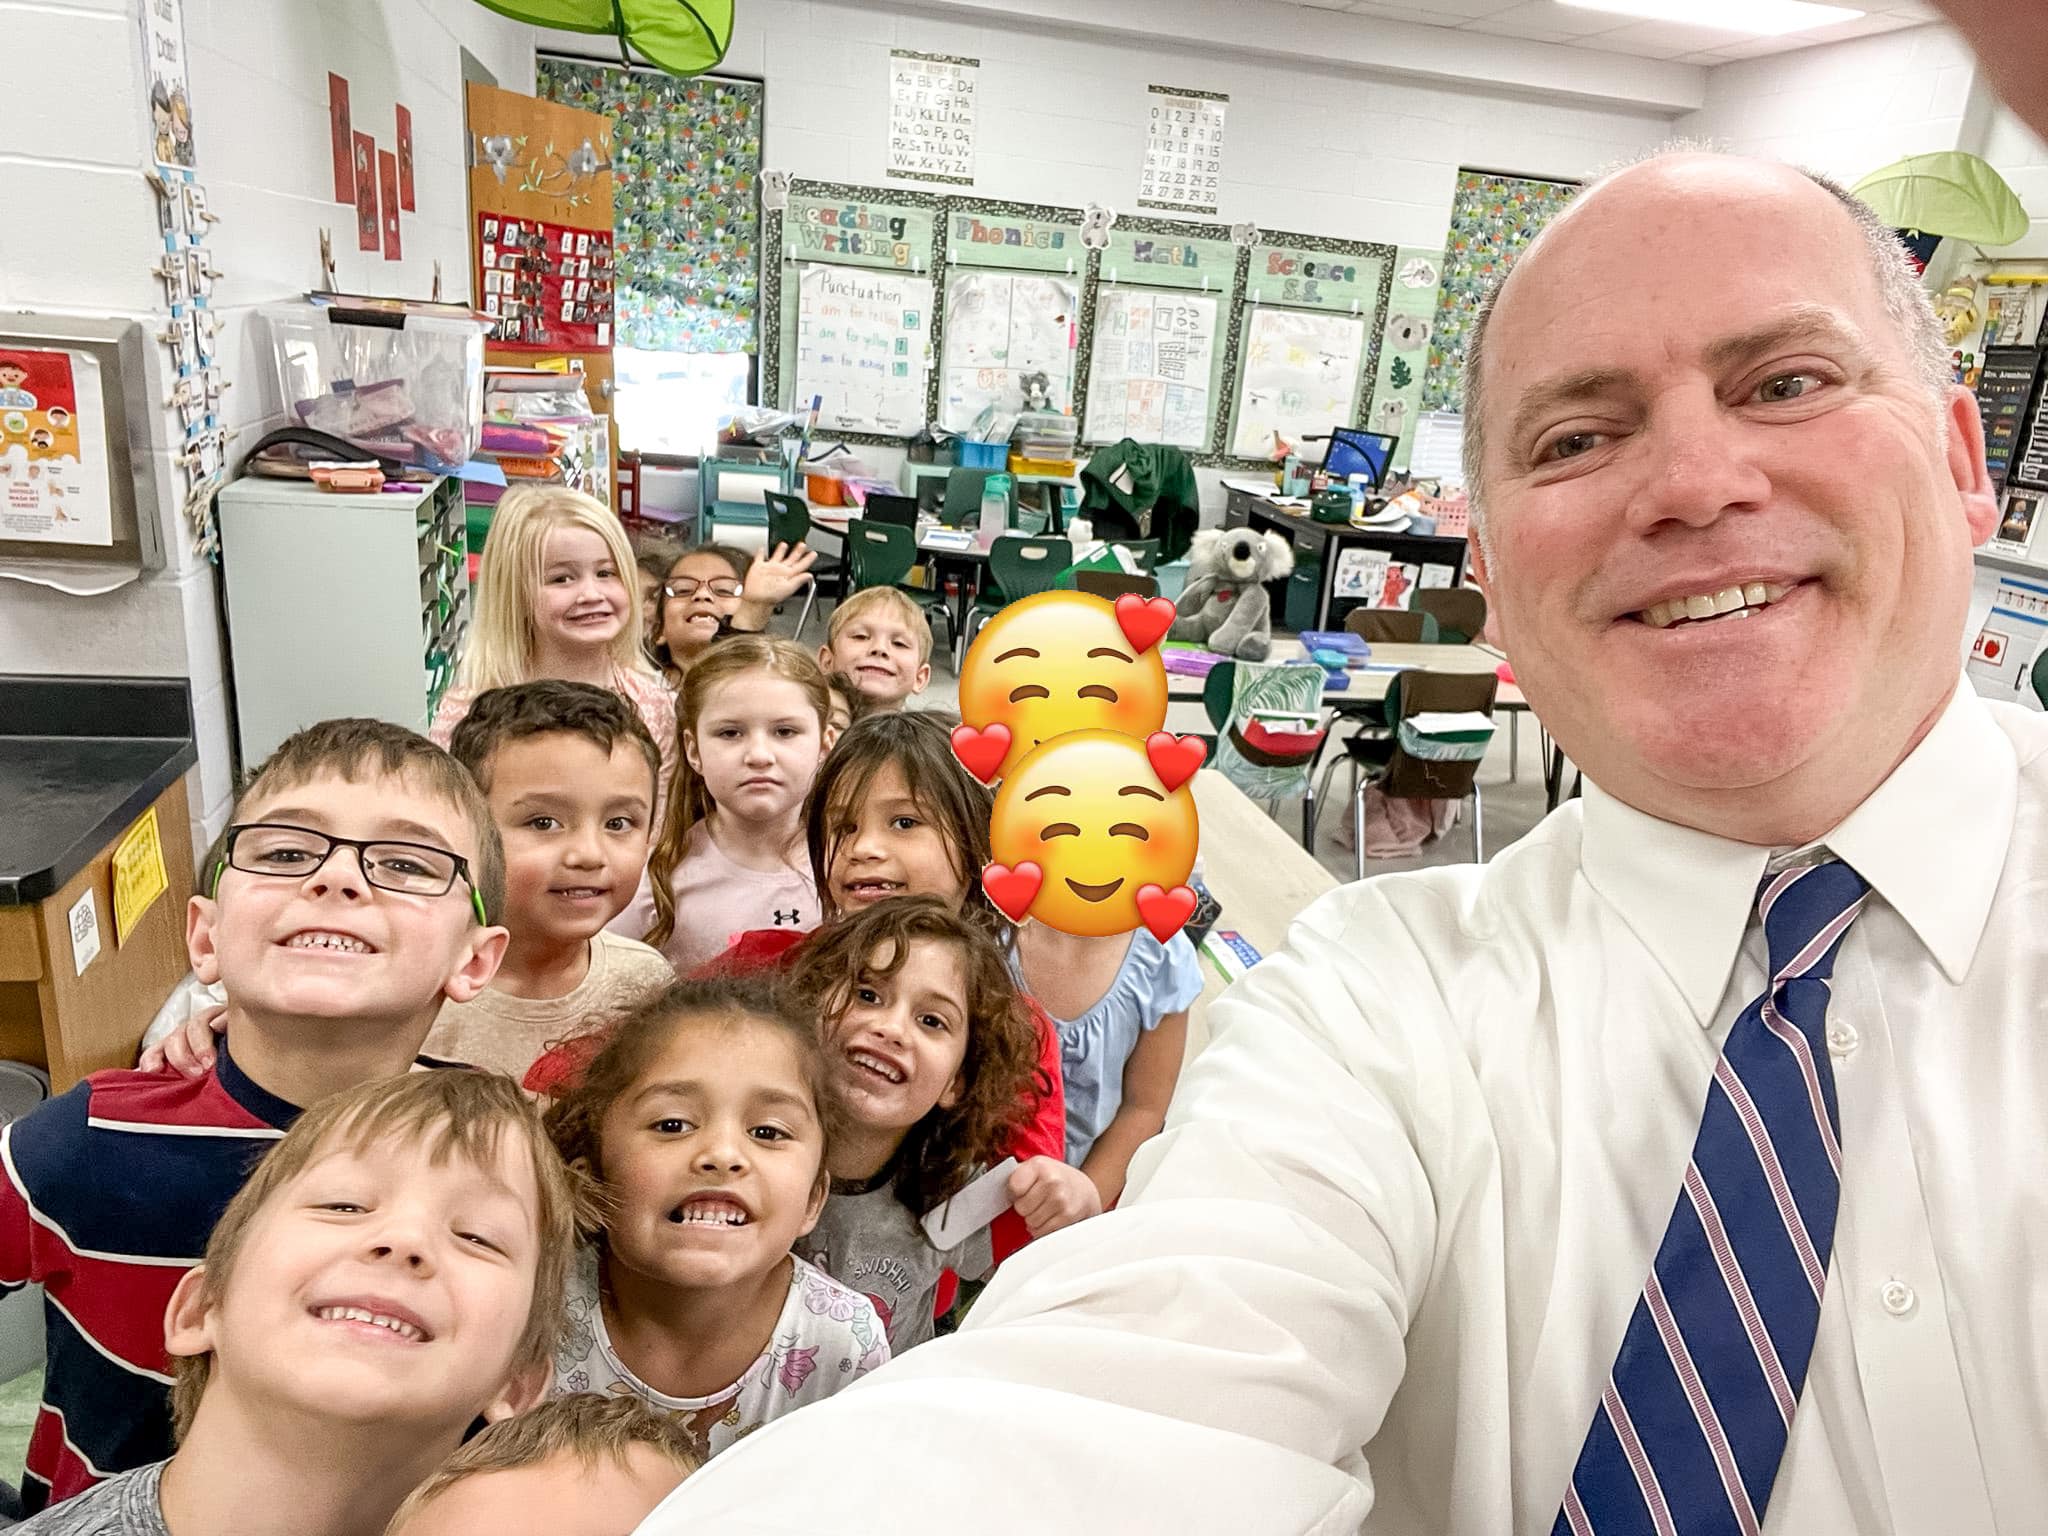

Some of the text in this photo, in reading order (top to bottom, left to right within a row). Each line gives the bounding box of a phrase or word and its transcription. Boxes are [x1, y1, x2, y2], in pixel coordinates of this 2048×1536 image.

[896, 73, 911, 85] Aa
[918, 76, 932, 87] Bb
[958, 80, 973, 93] Dd
[935, 95, 949, 110] Gg
[955, 96, 969, 108] Hh
[920, 108, 933, 120] Kk
[937, 111, 947, 121] Ll
[952, 112, 971, 124] Mm
[1152, 108, 1159, 118] 0
[1175, 111, 1181, 122] 2
[1189, 112, 1195, 123] 3
[1202, 114, 1208, 124] 4
[1216, 116, 1221, 126] 5
[914, 124, 928, 136] Oo
[935, 127, 947, 141] Pp
[954, 129, 970, 144] Qq
[1151, 123, 1221, 141] 6 7 8 9 10
[893, 138, 969, 157] Rr Ss Tt Uu Vv
[1148, 139, 1219, 157] 11 12 13 14 15
[894, 154, 966, 173] Ww Xx Yy Zz
[1147, 153, 1219, 172] 16 17 18 19 20
[1144, 169, 1217, 187] 21 22 23 24 25
[1142, 185, 1216, 202] 26 27 28 29 30
[787, 201, 907, 240] Reading
[956, 217, 1065, 249] Phonics
[801, 224, 911, 267] Writing
[1134, 240, 1198, 267] Math
[1266, 252, 1356, 283] Science
[820, 271, 902, 305] Punctuation
[801, 297, 812, 314] I
[821, 304, 840, 317] am
[800, 320, 812, 335] I
[819, 327, 836, 340] am
[800, 347, 813, 361] I
